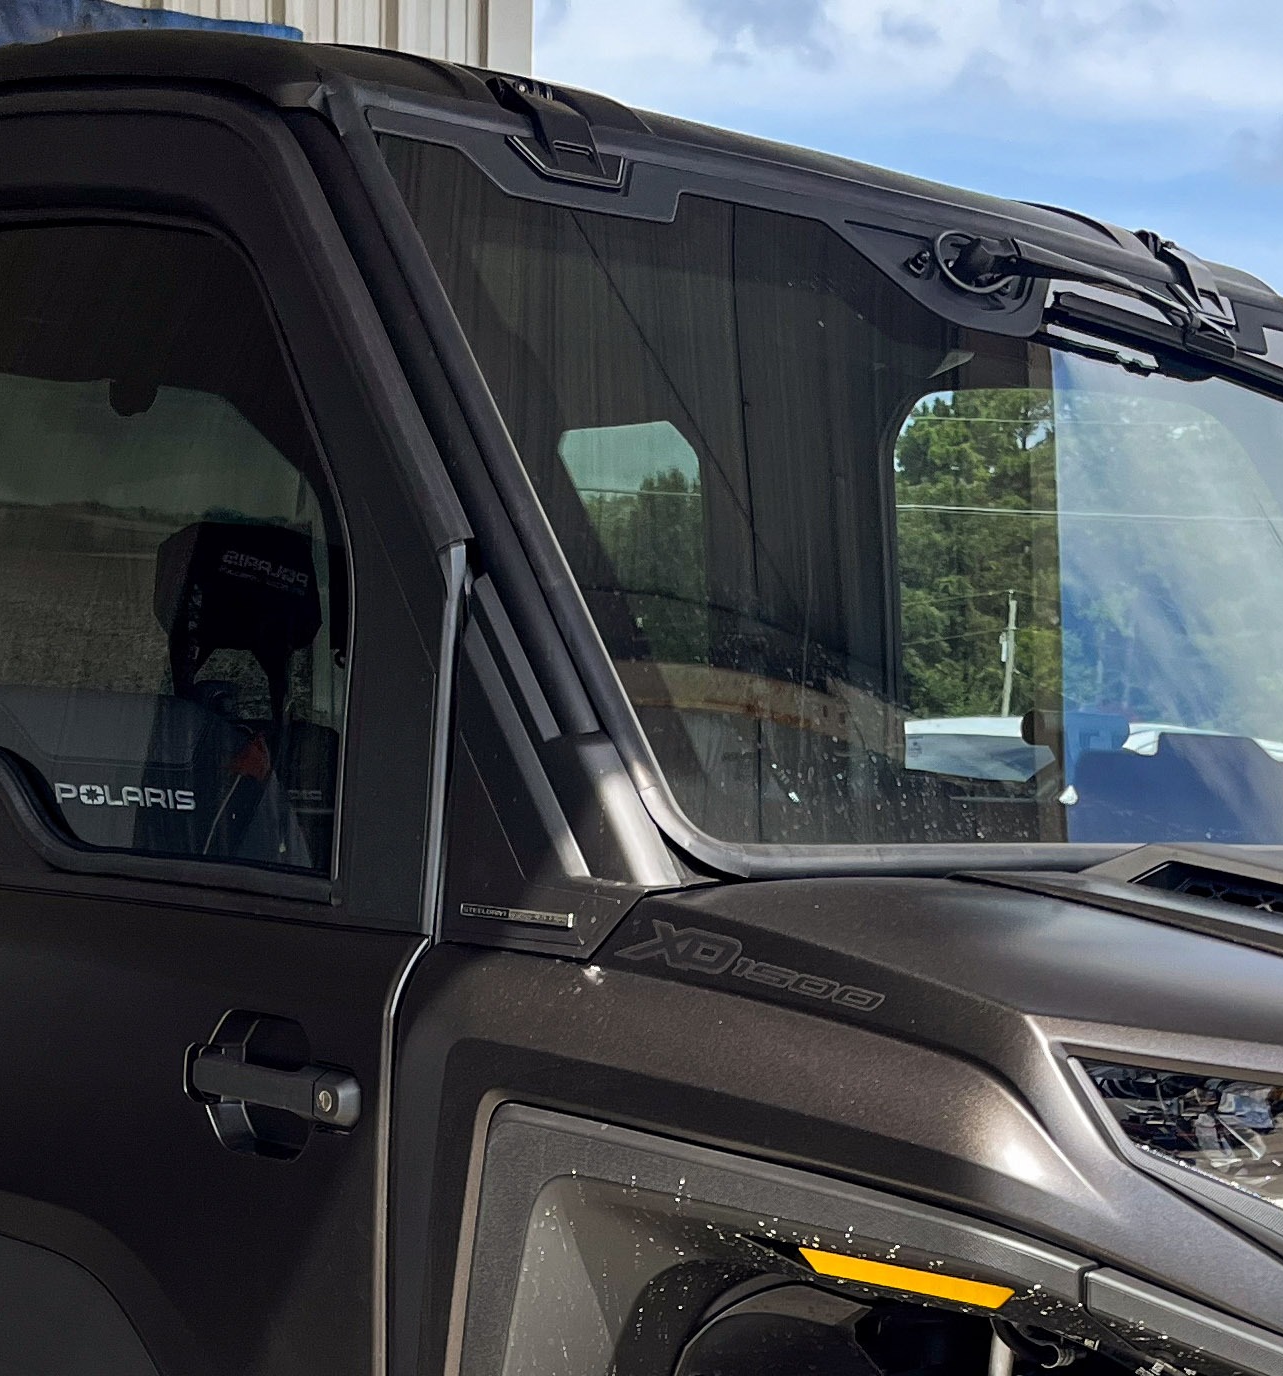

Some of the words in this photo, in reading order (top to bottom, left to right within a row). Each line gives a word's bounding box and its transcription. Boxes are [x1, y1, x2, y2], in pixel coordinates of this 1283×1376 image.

[54, 782, 196, 811] POLARIS
[613, 918, 743, 975] XD
[732, 956, 886, 1012] 1500
